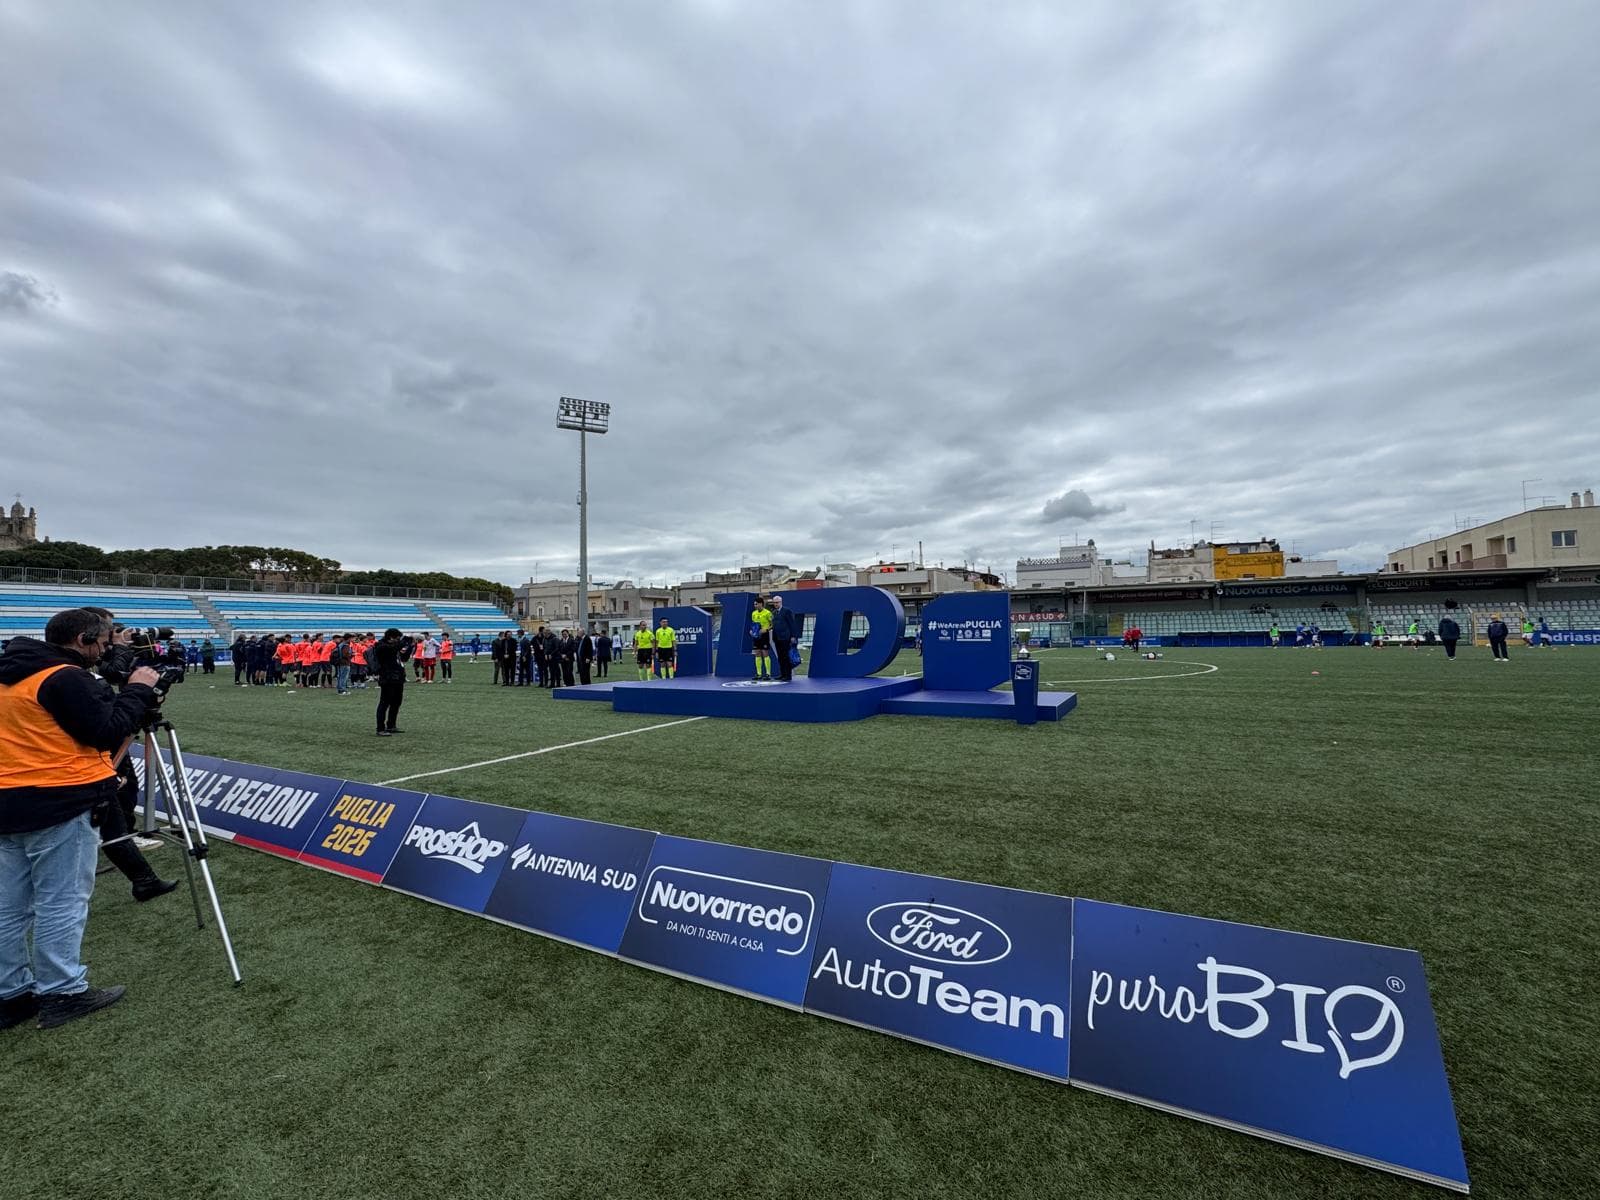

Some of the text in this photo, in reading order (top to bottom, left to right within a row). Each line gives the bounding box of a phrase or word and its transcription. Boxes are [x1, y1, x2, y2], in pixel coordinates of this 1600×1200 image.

[215, 778, 319, 829] REGIONI
[329, 795, 396, 829] PUGLIA
[312, 824, 378, 857] 2026
[405, 822, 505, 864] PROSHOP
[525, 853, 637, 892] ANTENNA SUD
[650, 880, 804, 935] Nuovarredo
[666, 920, 764, 953] DA NOI TI SENTI A CASA
[890, 908, 983, 959] Ford
